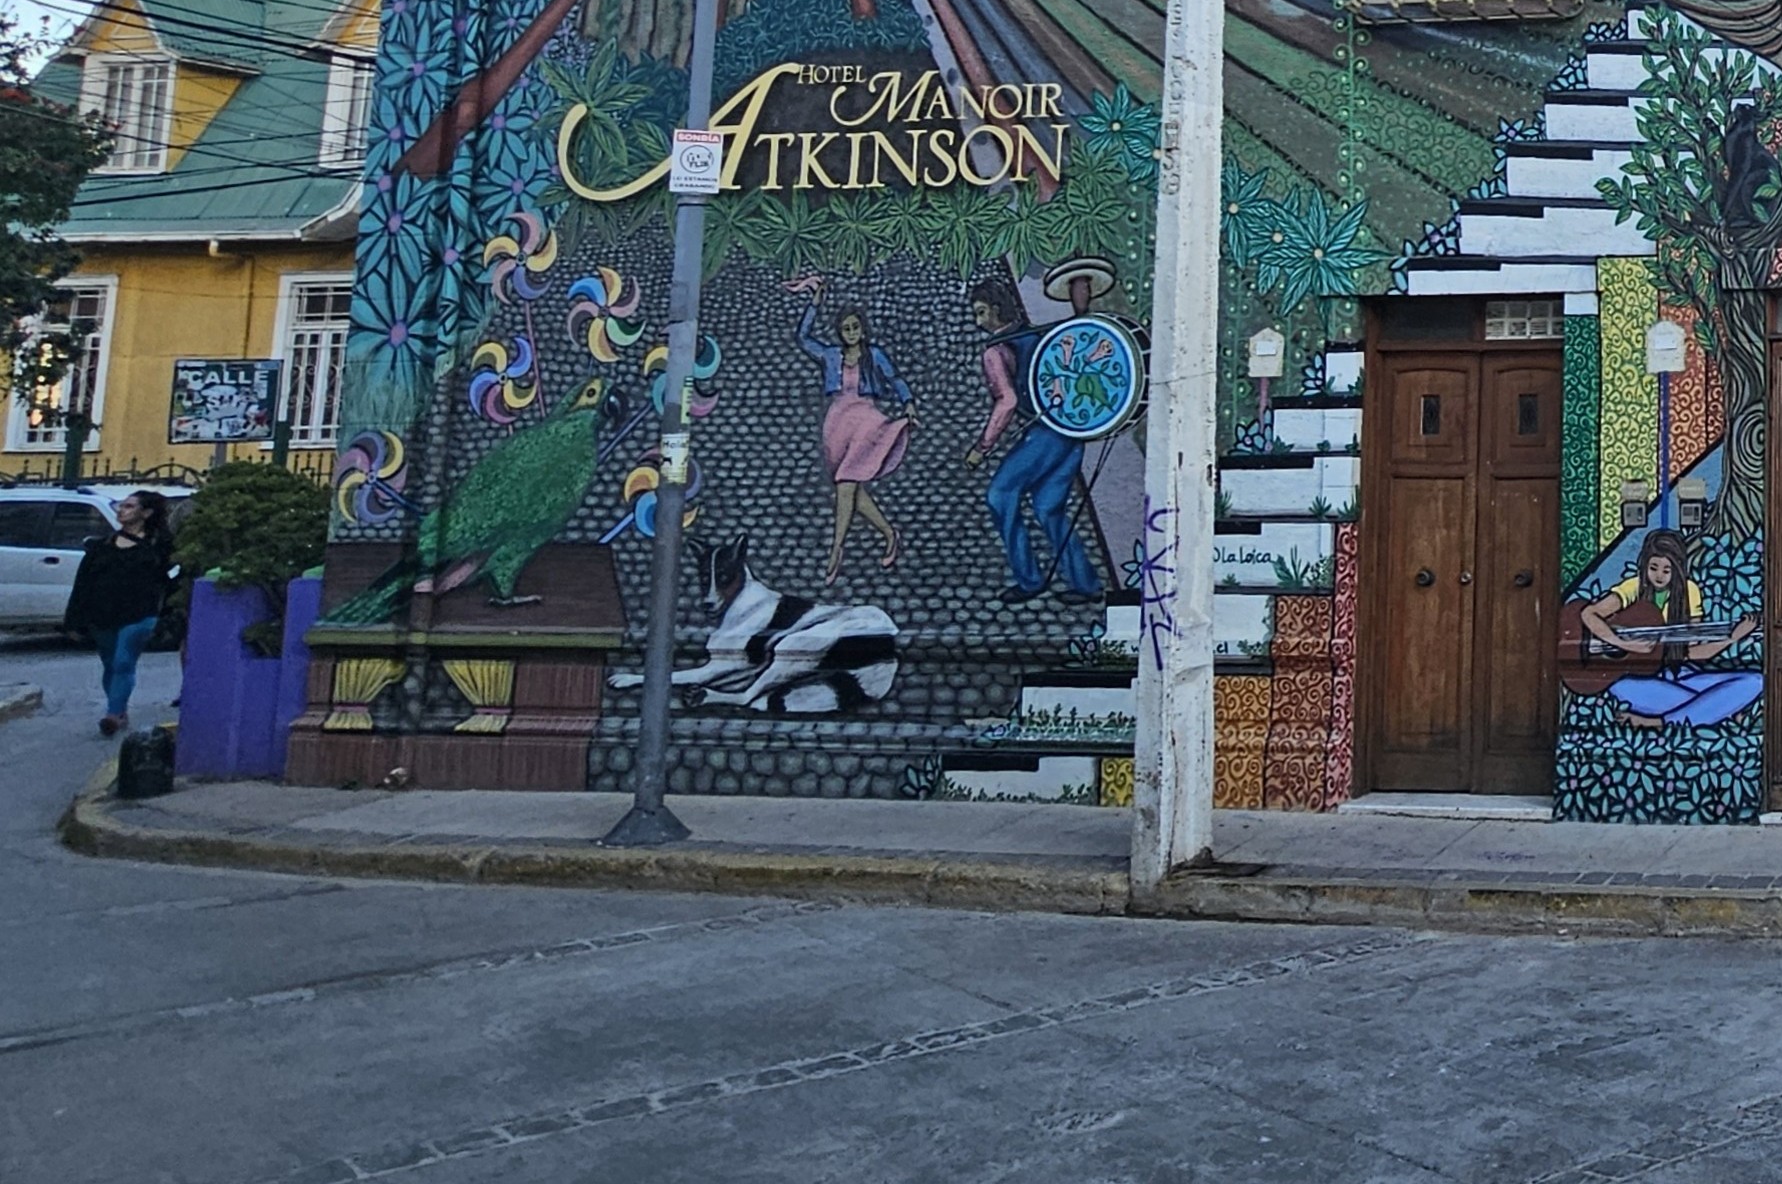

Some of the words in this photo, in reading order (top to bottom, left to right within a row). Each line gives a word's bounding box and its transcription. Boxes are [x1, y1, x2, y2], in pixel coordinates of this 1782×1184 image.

[797, 64, 866, 84] HOTEL
[830, 70, 1065, 127] MANOIR
[558, 62, 1071, 201] ATKINSON
